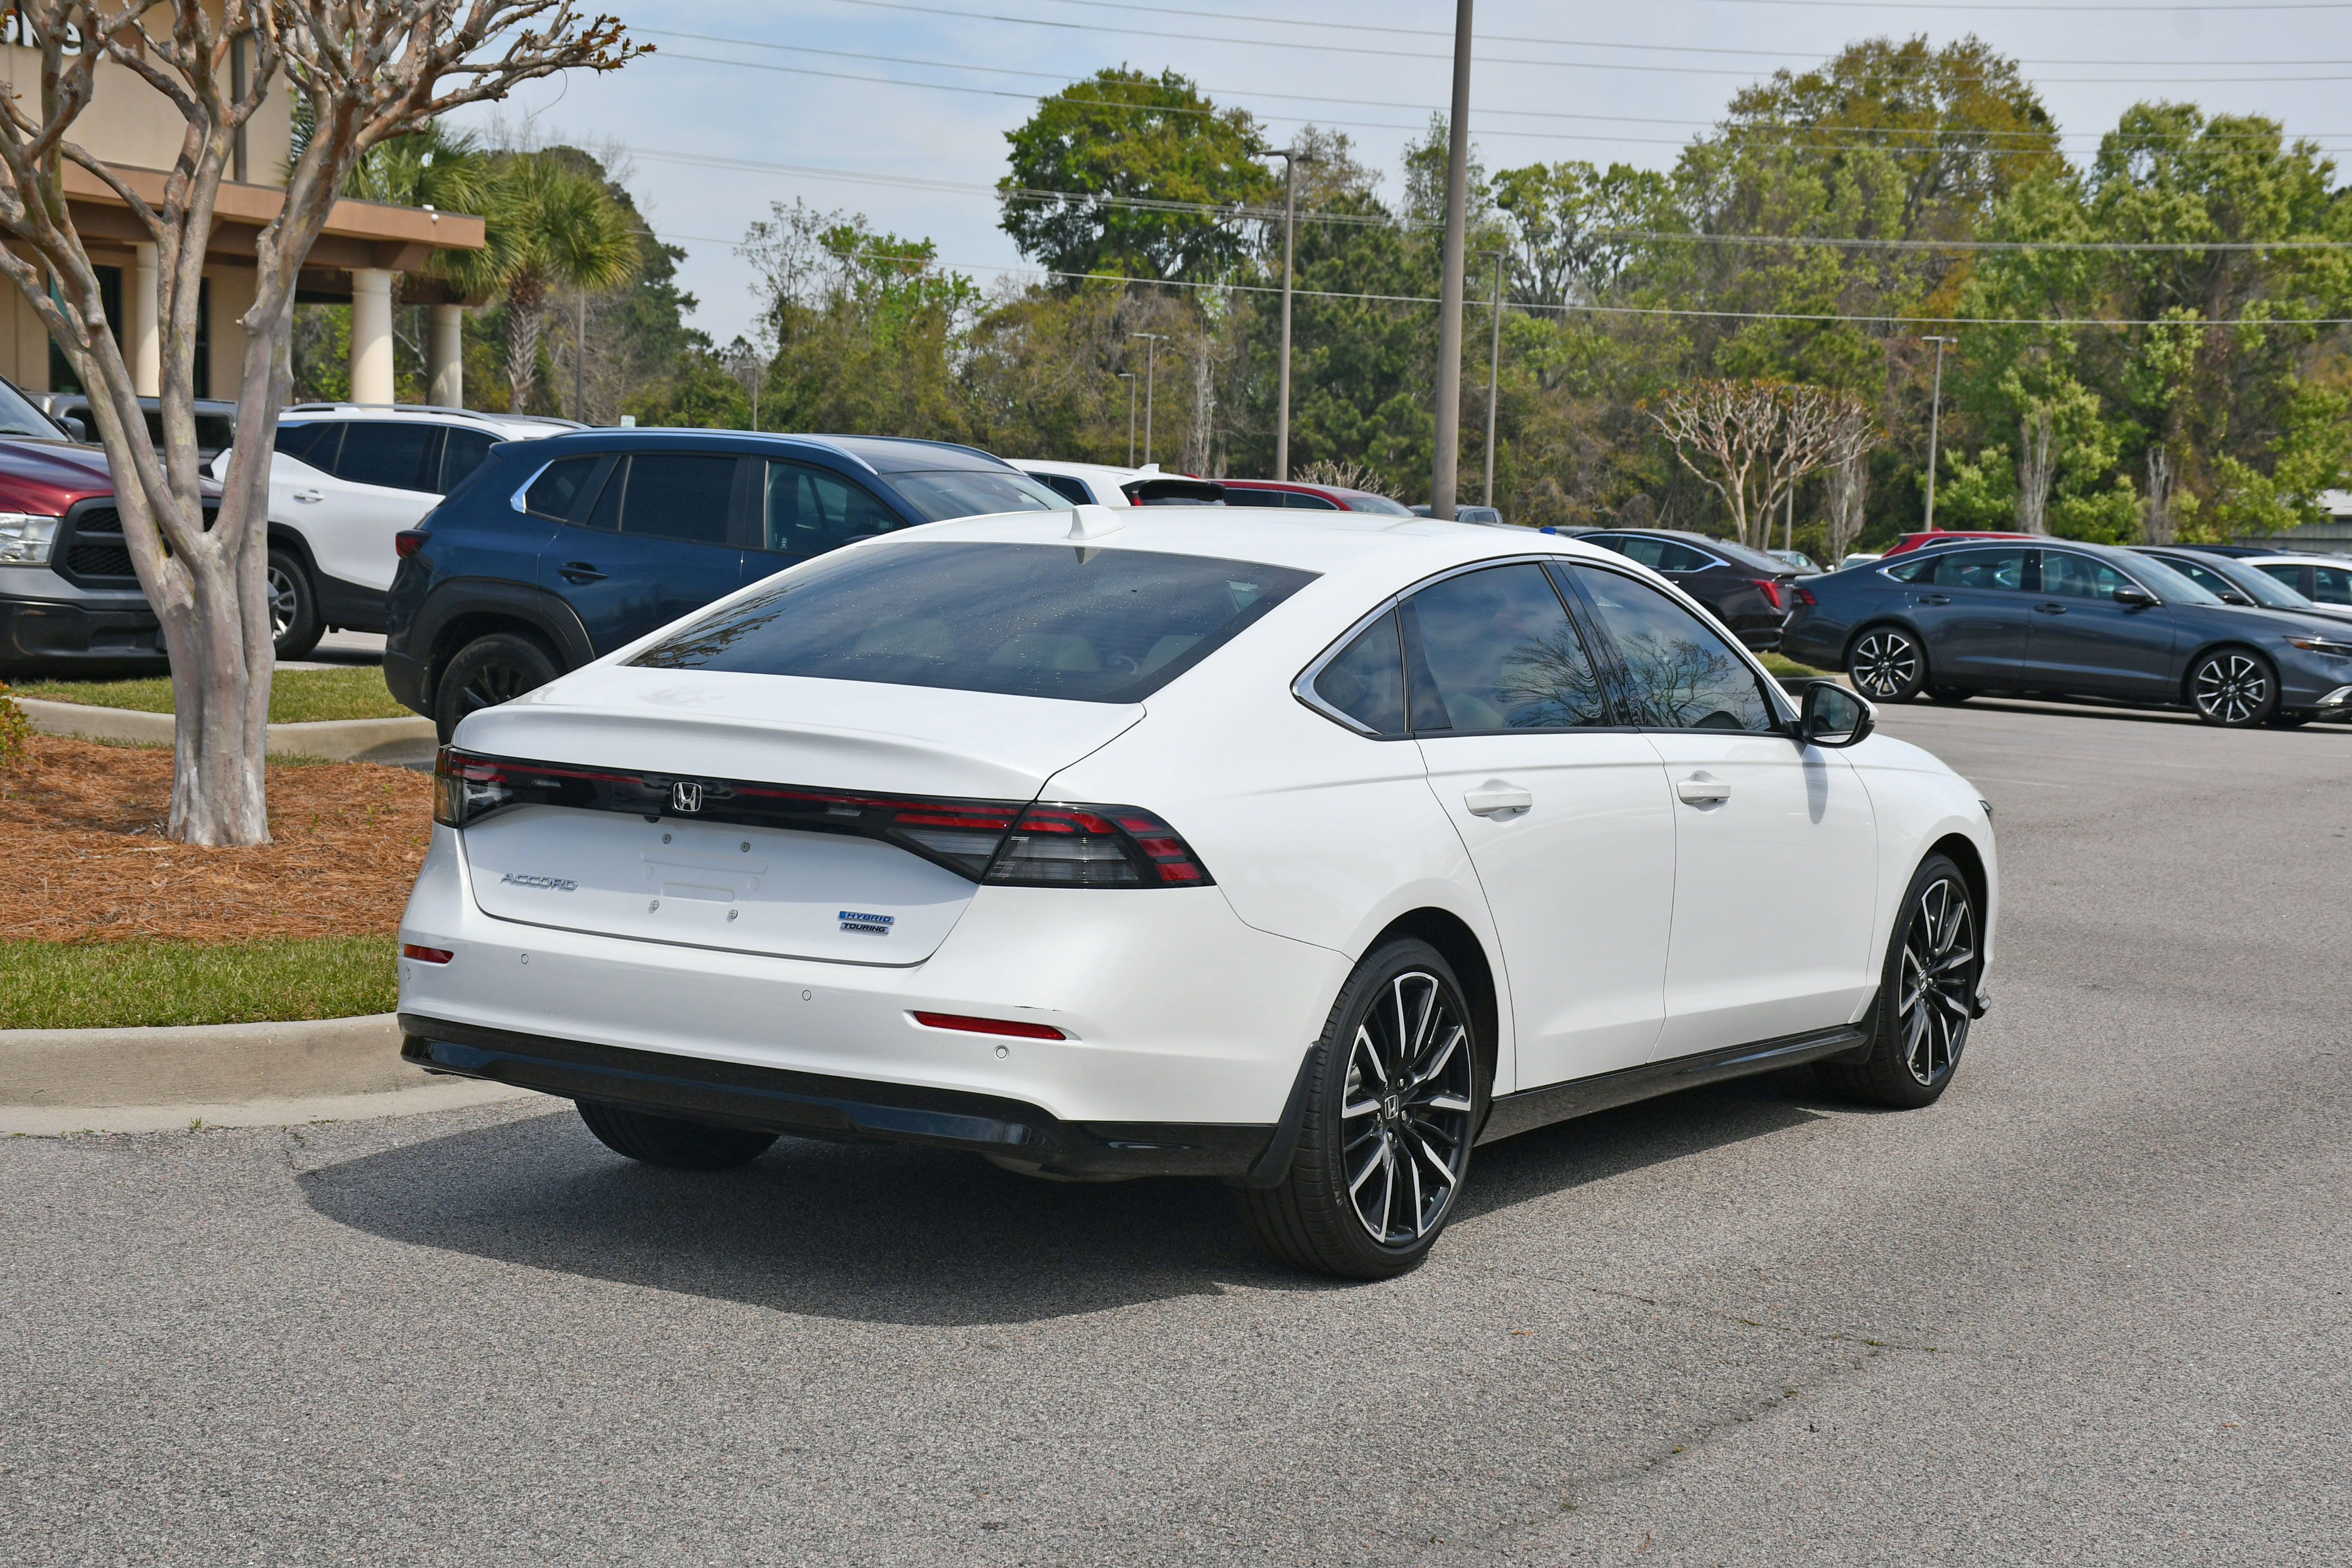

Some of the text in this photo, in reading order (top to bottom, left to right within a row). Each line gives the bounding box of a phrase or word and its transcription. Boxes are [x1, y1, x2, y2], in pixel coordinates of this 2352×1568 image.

[500, 872, 578, 890] ACCORD
[847, 912, 892, 922] HYBRID
[844, 923, 886, 932] TOURING
